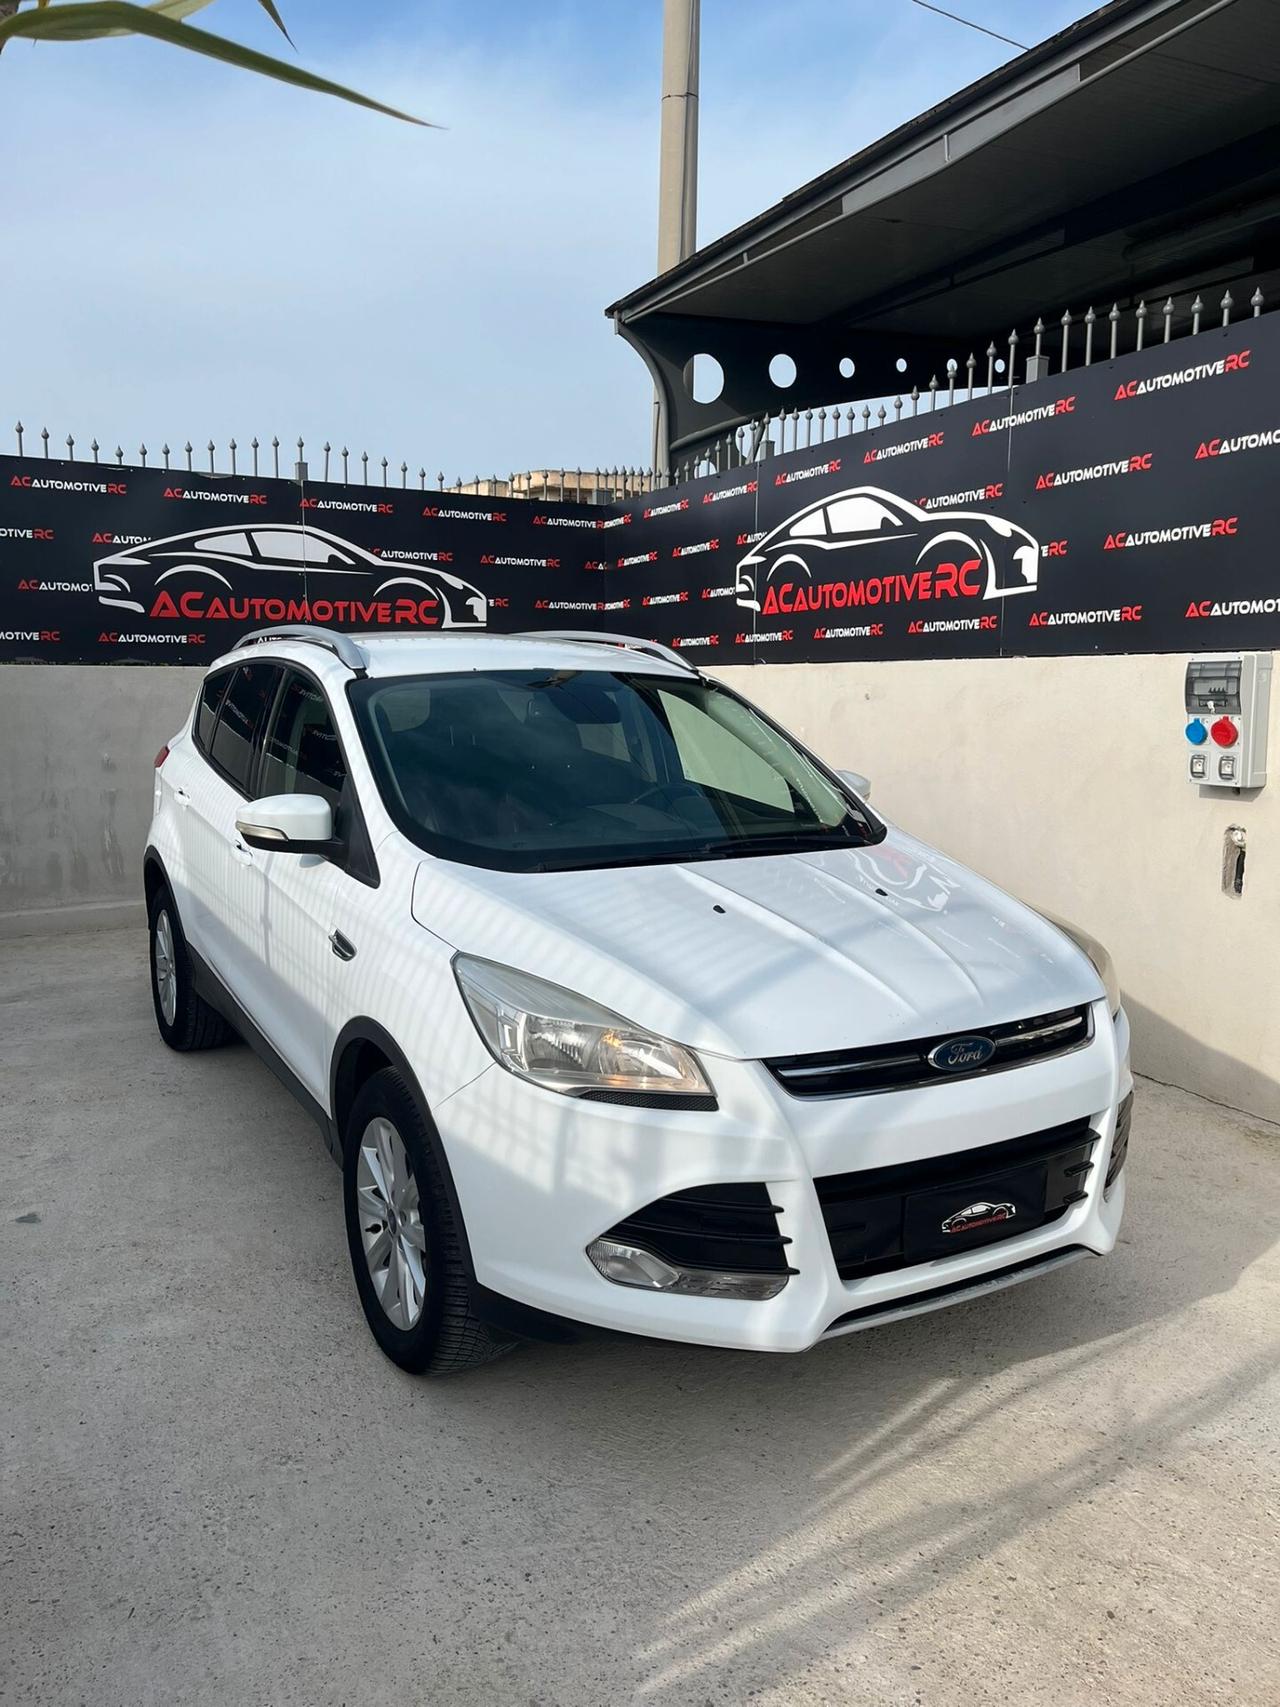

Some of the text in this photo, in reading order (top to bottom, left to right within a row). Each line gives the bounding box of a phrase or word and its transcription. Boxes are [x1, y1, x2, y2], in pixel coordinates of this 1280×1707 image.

[1114, 350, 1251, 400] ACAUTOMOTIVERC
[971, 396, 1076, 436] ACAUTOMOTIVERC
[864, 432, 944, 463] ACAUTOMOTIVERC
[775, 459, 842, 485] ACAUTOMOTIVERC
[1035, 453, 1153, 490] ACAUTOMOTIVERC
[10, 475, 127, 494] ACAUTOMOTIVERC
[703, 480, 758, 504] ACAUTOMOTIVERC
[163, 488, 267, 505] ACAUTOMOTIVERC
[300, 498, 394, 514] ACAUTOMOTIVERC
[422, 507, 507, 522] ACAUTOMOTIVERC
[1104, 517, 1238, 549] ACAUTOMOTIVERC
[480, 555, 560, 568] ACAUTOMOTIVERC
[762, 560, 982, 615] ACAUTOMOTIVERC
[150, 590, 439, 624] ACAUTOMOTIVERC
[1029, 605, 1142, 627] ACAUTOMOTIVERC
[814, 624, 884, 639] ACAUTOMOTIVERC
[908, 616, 998, 633] ACAUTOMOTIVERC
[98, 632, 206, 644] ACAUTOMOTIVERC
[735, 630, 793, 644] ACAUTOMOTIVERC
[948, 1042, 984, 1065] Ford
